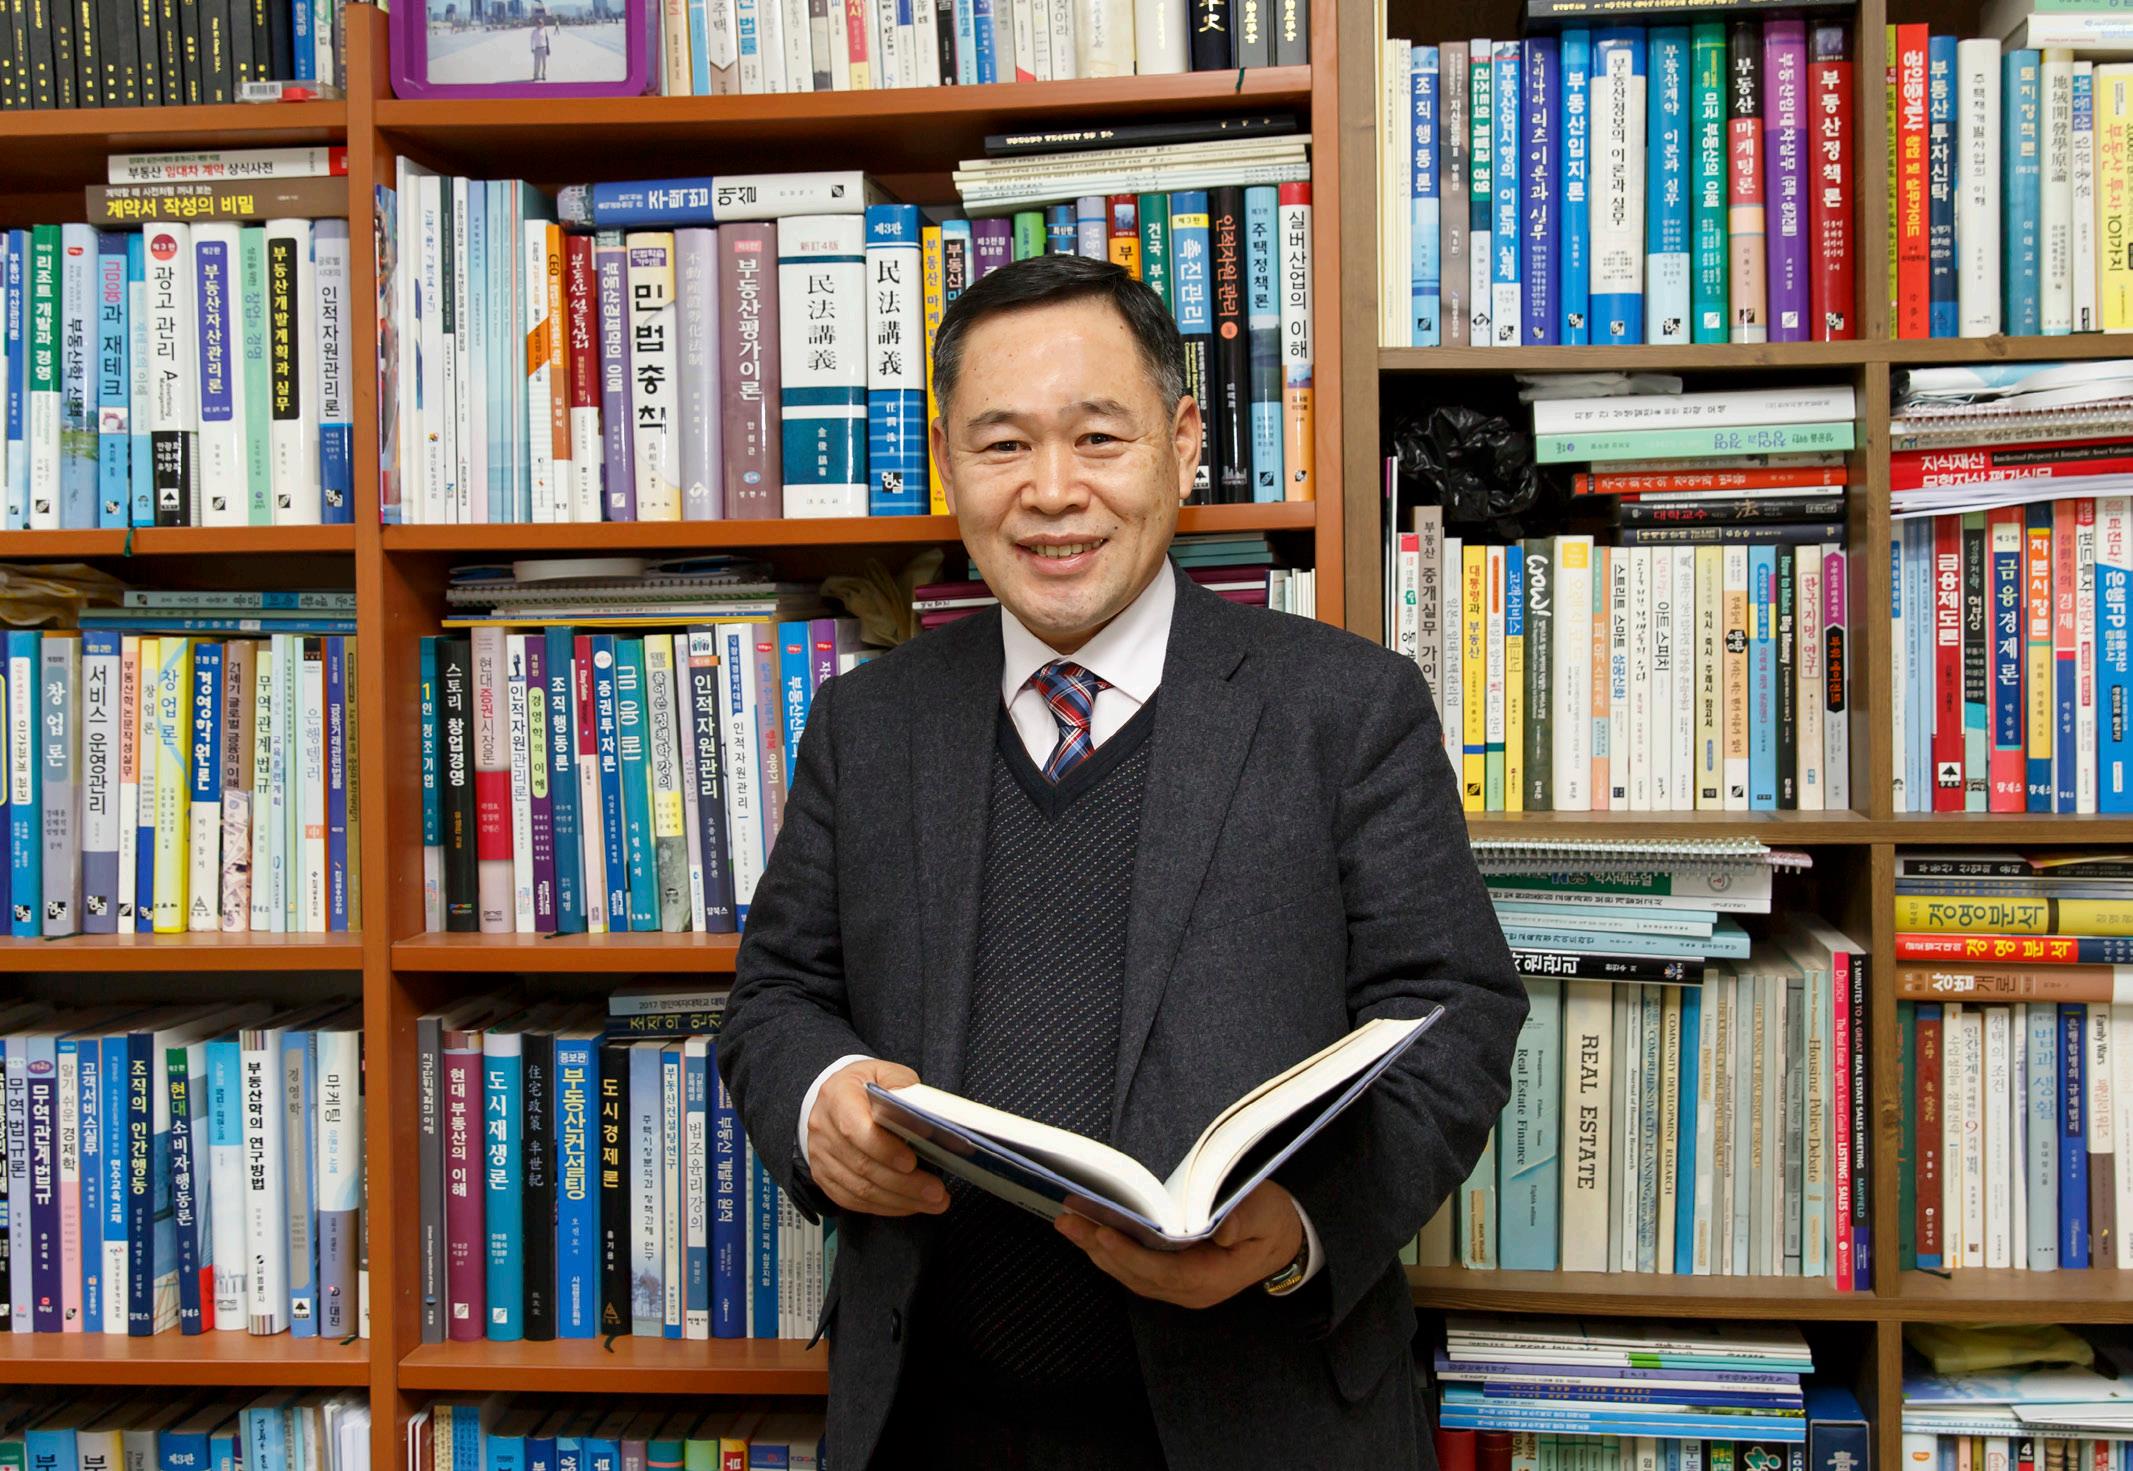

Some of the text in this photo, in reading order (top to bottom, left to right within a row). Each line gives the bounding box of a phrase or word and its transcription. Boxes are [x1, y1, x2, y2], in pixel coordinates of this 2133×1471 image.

[128, 160, 274, 179] 부동산 계약 상식사전
[1414, 76, 1433, 193] 조직행동론
[1567, 71, 1585, 202] 부동산입지론
[1735, 57, 1755, 195] 부동산 마케팅론
[1821, 70, 1842, 208] 부동산정책론
[1903, 50, 1924, 238] 공인중개사 창업 및 실무가이드
[1930, 60, 1949, 202] 부동산 투자신탁
[107, 194, 255, 219] 계약서 작성의 비밀
[648, 186, 757, 210] 주택법 해설
[874, 222, 903, 235] 제3판
[1702, 180, 1719, 207] 이해
[946, 243, 963, 289] 부동산
[1178, 238, 1206, 325] 촉진관리
[1215, 215, 1240, 318] 인적자원관리
[1253, 222, 1270, 310] 주택정책론
[1289, 210, 1308, 360] 실버산업의 이해
[67, 318, 84, 381] 부동산학
[103, 260, 123, 396] 금융과 재테크
[155, 266, 176, 361] 광고관리
[204, 263, 224, 394] 부동산자산관리론
[321, 286, 340, 418] 인적자원관리론
[602, 262, 622, 359] 부동산경제학의
[736, 258, 764, 402] 부동산평가이론
[807, 274, 837, 371] 民法講義
[877, 259, 903, 377] 民法講義
[275, 380, 291, 412] 실무
[635, 283, 666, 435] 민법총칙
[1921, 452, 1985, 472] 지식재산
[1421, 520, 1437, 638] 부동산 중개실무
[1507, 568, 1522, 633] 고객서비스
[1780, 556, 1792, 577] How
[1780, 588, 1792, 615] Make
[1937, 553, 1960, 647] 금융제도론
[2031, 538, 2050, 637] 자본시장론
[2078, 532, 2093, 593] 펀드투자
[2105, 570, 2126, 628] 은행FP
[1468, 564, 1481, 659] 대통령과 부동산
[1612, 563, 1627, 700] 스트리트 스마트 성공신화
[1655, 601, 1670, 671] 아트 스피치
[1779, 615, 1792, 633] Big
[1779, 633, 1792, 664] Money
[1967, 596, 1982, 631] 협상
[1997, 557, 2020, 686] 금융경제론
[2058, 592, 2073, 630] 경제
[46, 683, 66, 768] 창업론
[89, 664, 107, 816] 서비스 운영관리
[160, 668, 179, 748] 창업론
[196, 671, 214, 791] 경영학원론
[227, 662, 241, 789] 21세기 글로벌 금융의 이해
[256, 674, 272, 795] 무역관계법규
[421, 683, 435, 790] 1인 창조기업
[446, 663, 466, 788] 스토리 창업경영
[479, 656, 494, 766] 현대증권시장론
[510, 685, 528, 802] 인적자원관리론
[551, 676, 570, 773] 조직행동론
[598, 680, 616, 773] 증권투자론
[618, 665, 643, 762] 금융론
[693, 674, 718, 800] 인적자원관리
[534, 762, 546, 791] 이해
[656, 759, 673, 791] 강의
[733, 722, 748, 810] 인적자원관리
[1928, 902, 2045, 929] 경영분석
[1965, 938, 2073, 959] 경영분석
[630, 1014, 683, 1030] 조직의
[638, 1001, 659, 1011] 2017
[1837, 1018, 1846, 1030] The
[1854, 967, 1863, 1004] MINUTES
[1854, 1004, 1863, 1017] TO
[1855, 1018, 1863, 1026] A
[559, 1052, 588, 1064] 증보판
[1837, 1031, 1846, 1047] Real
[1855, 1026, 1863, 1054] GREAT
[1855, 1054, 1864, 1076] REAL
[2033, 1028, 2054, 1121] 법과 생활
[2093, 1013, 2107, 1066] Family Wars
[8, 1077, 26, 1179] 무역법규론
[130, 1060, 149, 1196] 조직의 인간행동
[248, 1061, 265, 1192] 부동산학의 연구방법
[324, 1074, 341, 1124] 마케팅
[450, 1068, 467, 1198] 현대 부동산의 이해
[488, 1070, 509, 1192] 도시재생론
[562, 1067, 587, 1201] 부동산컨설팅
[602, 1077, 620, 1189] 도시경제론
[1516, 1048, 1528, 1166] Real Estate Finance
[1577, 1034, 1599, 1190] REAL ESTATE
[1628, 1106, 1636, 1136] Housing
[1630, 1096, 1637, 1105] of
[1664, 1013, 1676, 1195] COMMUNITY DEVELOPMENT RESEARCH
[1808, 1038, 1822, 1182] Housing Policy Debate
[1855, 1076, 1864, 1105] ESTATE
[1856, 1106, 1864, 1131] SALES
[32, 1084, 52, 1206] 무역관계법규
[62, 1126, 76, 1173] 경제학
[169, 1081, 194, 1227] 현대 소비자행동론
[717, 1115, 734, 1223] 부동산 개발의 원칙
[1628, 1137, 1636, 1171] Research
[1838, 1142, 1848, 1179] LISTING
[1856, 1132, 1864, 1169] MEETING
[1838, 1186, 1848, 1211] SALES
[1857, 1177, 1865, 1218] MAYFIELD
[2021, 1442, 2032, 1455] 4
